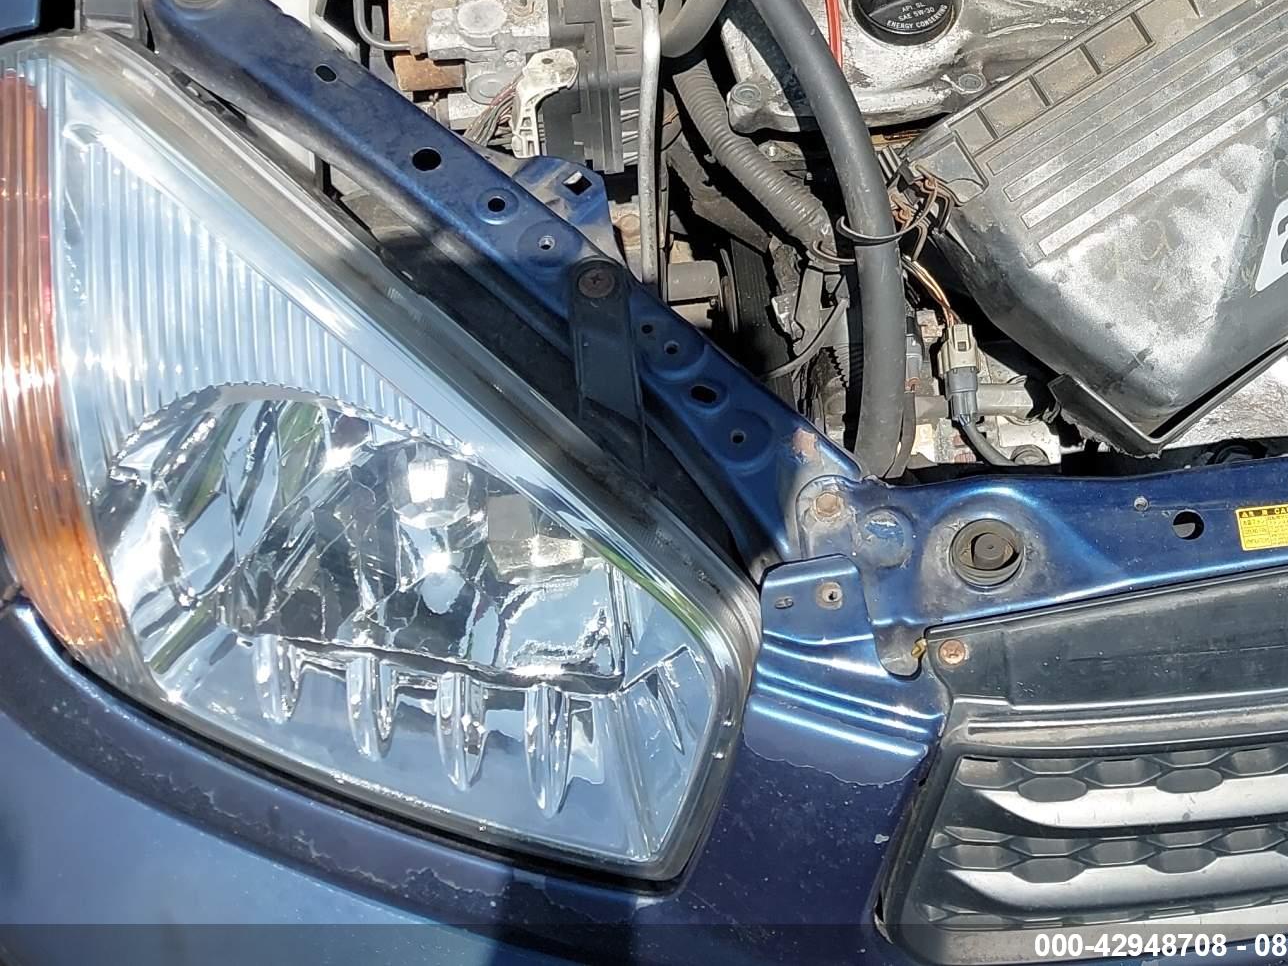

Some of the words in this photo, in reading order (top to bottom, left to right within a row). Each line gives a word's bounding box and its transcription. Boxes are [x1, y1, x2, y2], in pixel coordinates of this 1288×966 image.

[886, 20, 914, 30] ENERGY
[915, 4, 948, 28] CONSERVING
[898, 12, 913, 22] SAE
[913, 6, 935, 18] 5W-30
